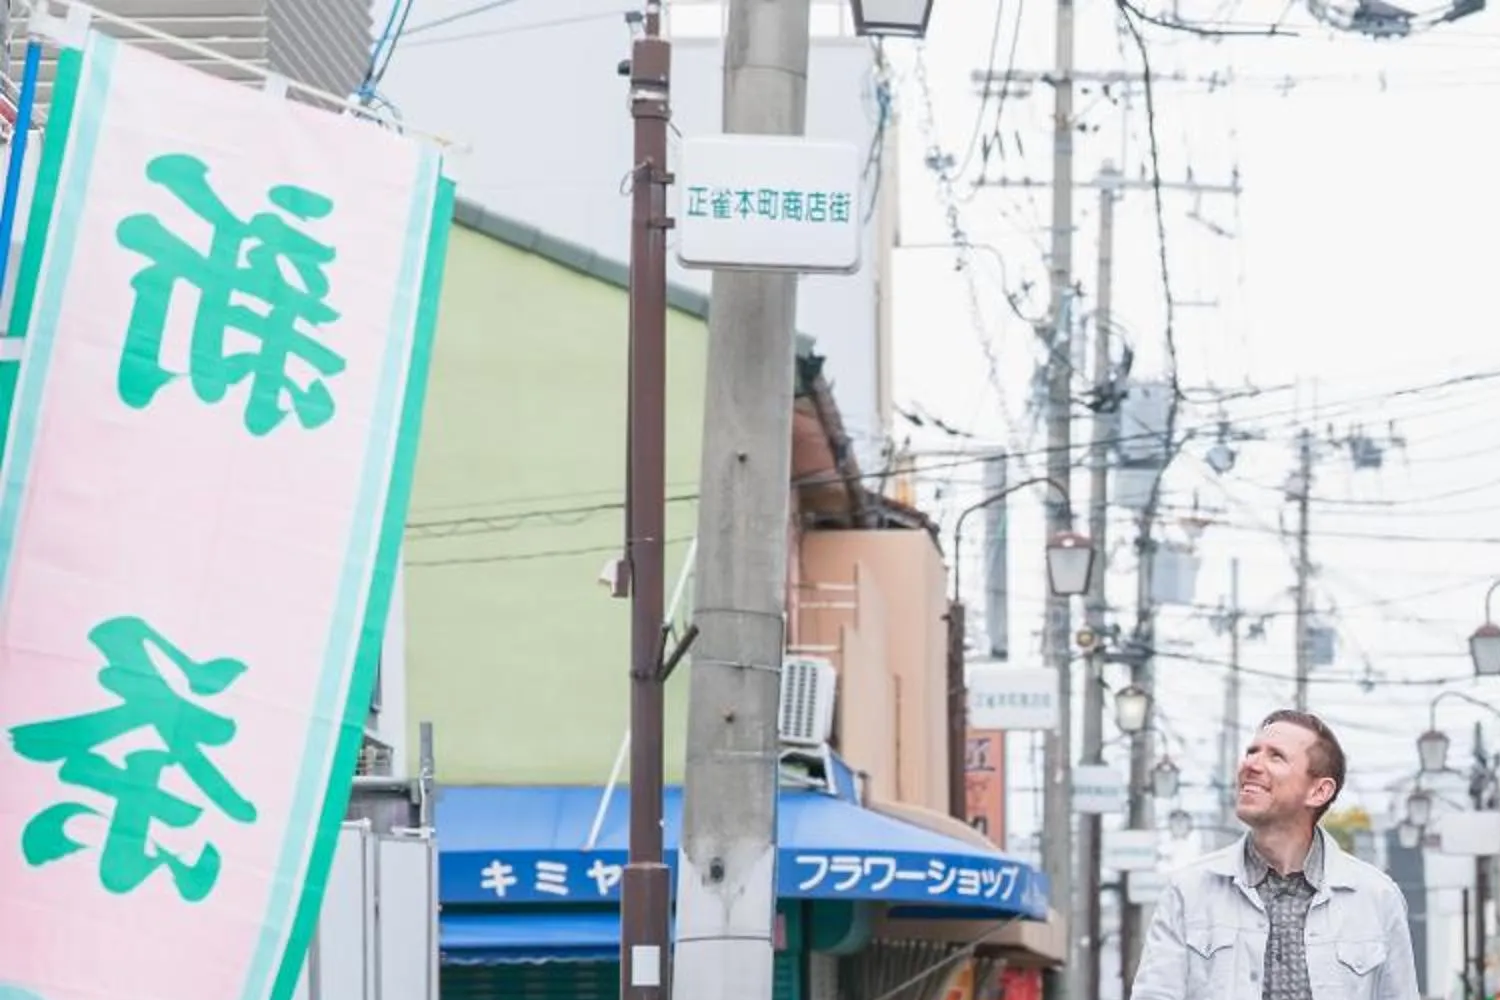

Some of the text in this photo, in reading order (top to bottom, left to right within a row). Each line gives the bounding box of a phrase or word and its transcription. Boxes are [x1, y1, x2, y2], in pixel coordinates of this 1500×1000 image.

[687, 186, 851, 223] 正雀本町商店街
[480, 856, 1019, 900] キミヤ フラワーショップ
